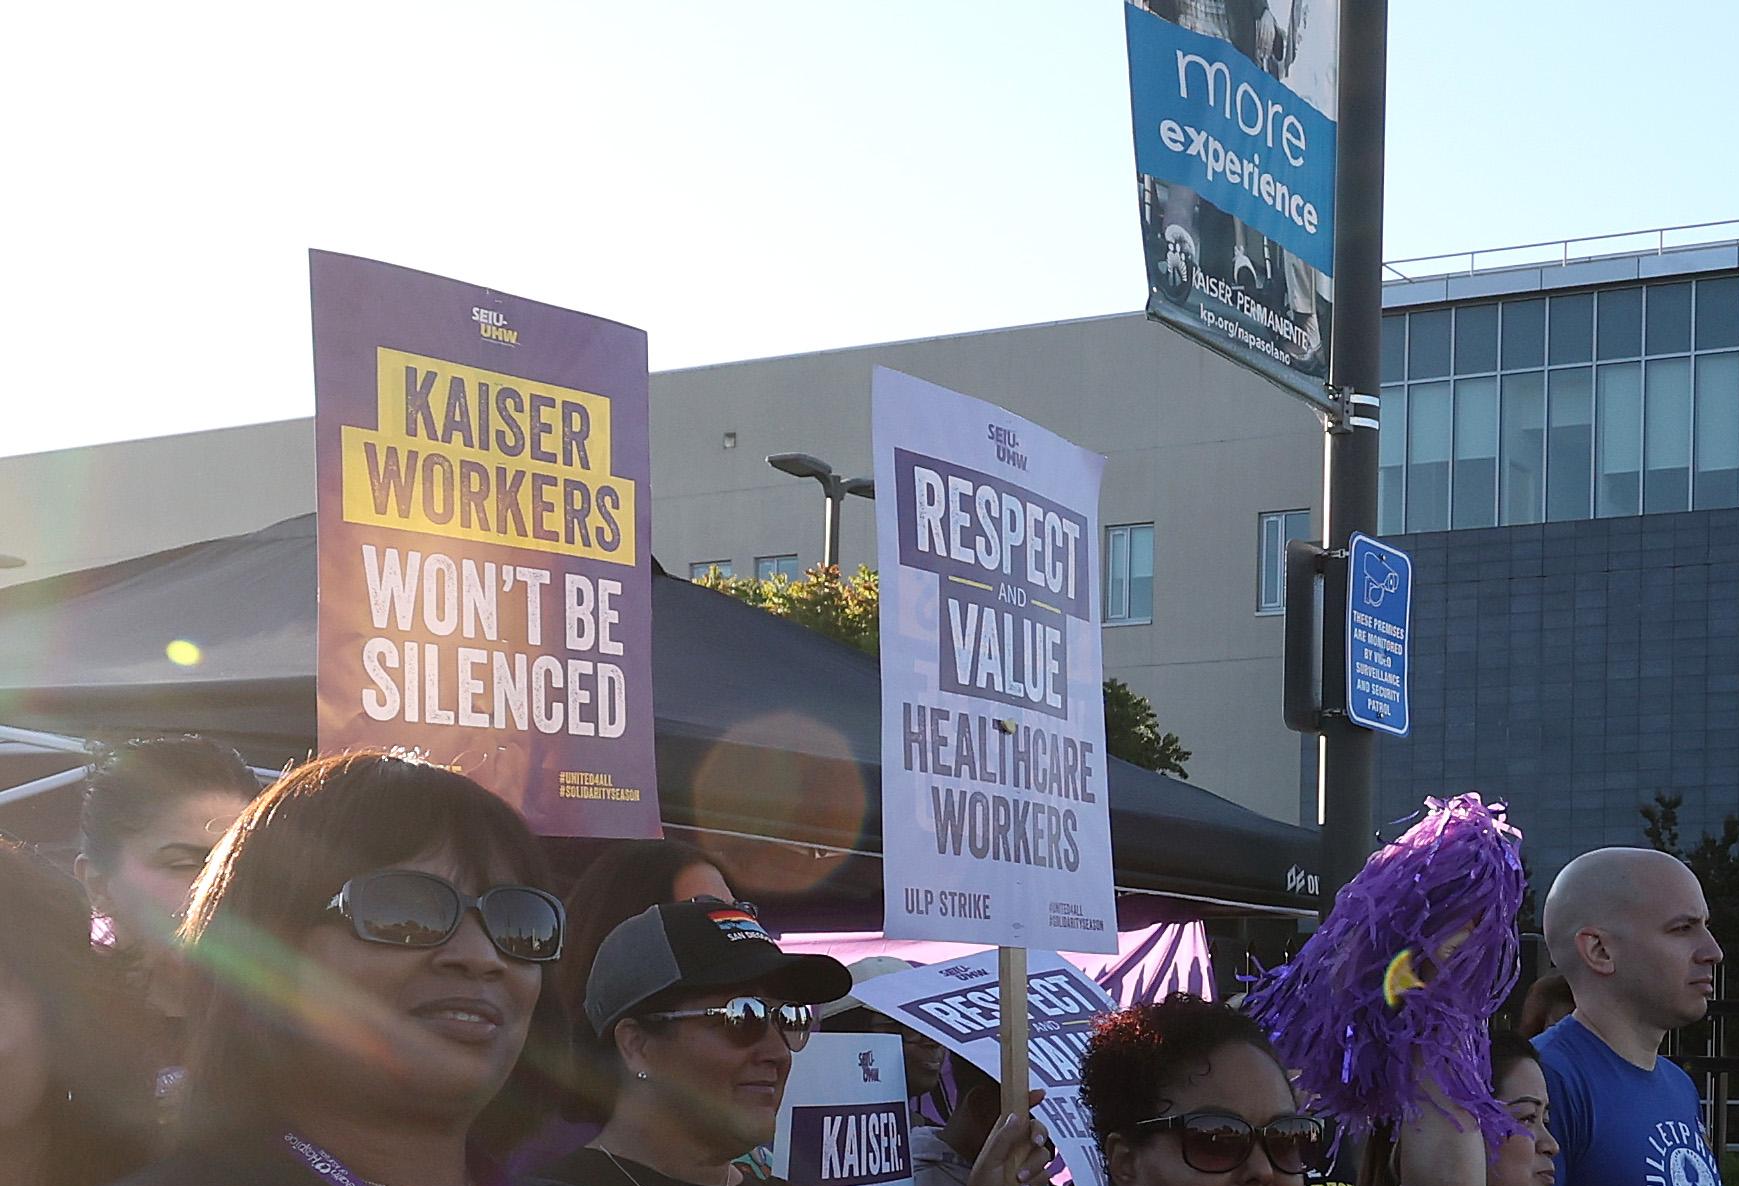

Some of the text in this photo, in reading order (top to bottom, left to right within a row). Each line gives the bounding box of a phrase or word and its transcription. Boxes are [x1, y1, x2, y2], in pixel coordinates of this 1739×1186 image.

[1176, 49, 1306, 167] more
[1160, 119, 1318, 234] experience
[472, 306, 508, 328] SEIU-
[1192, 266, 1308, 350] KAISER PERMANENTE
[480, 322, 518, 343] UHW
[1200, 303, 1290, 365] kp.org/napasolano
[405, 365, 591, 470] KAISER
[996, 444, 1027, 471] UHW
[363, 442, 621, 552] WORKERS
[913, 466, 1081, 600] RESPECT
[361, 545, 625, 656] WON'T BE
[998, 582, 1027, 608] AND
[1353, 610, 1405, 640] THESE PREMISES
[1354, 627, 1403, 655] ARE MONITORED
[948, 599, 1062, 709] VALUE
[1356, 662, 1400, 688] SURVEILLANCE
[1364, 648, 1392, 668] BY VIDEO
[361, 637, 626, 738] SILENCED
[1357, 679, 1400, 703] AND SECURITY
[1368, 698, 1391, 716] PATROL
[903, 702, 1095, 803] HEALTHCARE
[559, 771, 613, 786] #UNITED4ALL
[559, 785, 640, 801] #SOLIDARITYSEASON
[931, 786, 1080, 873] WORKERS
[905, 887, 991, 920] ULP STRIKE
[918, 974, 1097, 1035] RESECT
[1032, 1020, 1061, 1032] AND
[821, 1111, 903, 1180] KAISER:
